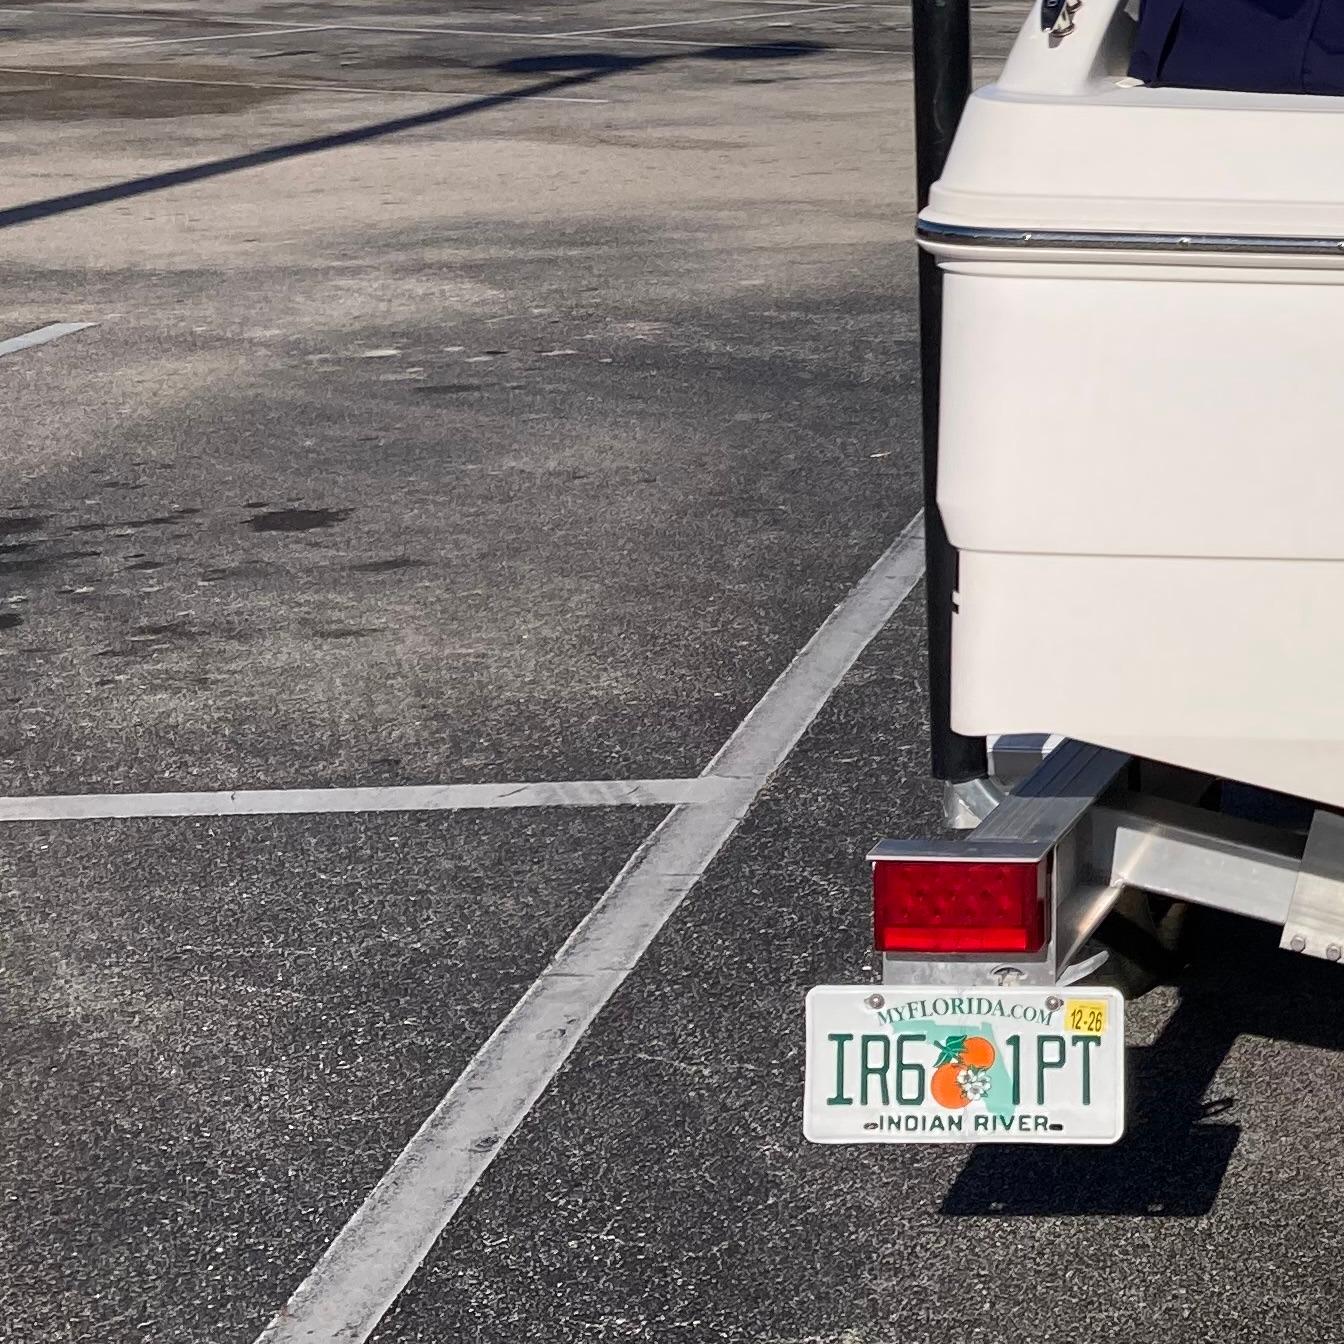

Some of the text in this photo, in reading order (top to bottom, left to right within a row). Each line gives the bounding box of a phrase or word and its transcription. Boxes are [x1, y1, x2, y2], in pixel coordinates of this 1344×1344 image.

[877, 997, 1053, 1027] MYFLORIDA.COM
[1070, 1009, 1103, 1033] 12-26
[826, 1033, 1102, 1106] IR6 1PT
[879, 1114, 1049, 1131] INDIAN RIVER
